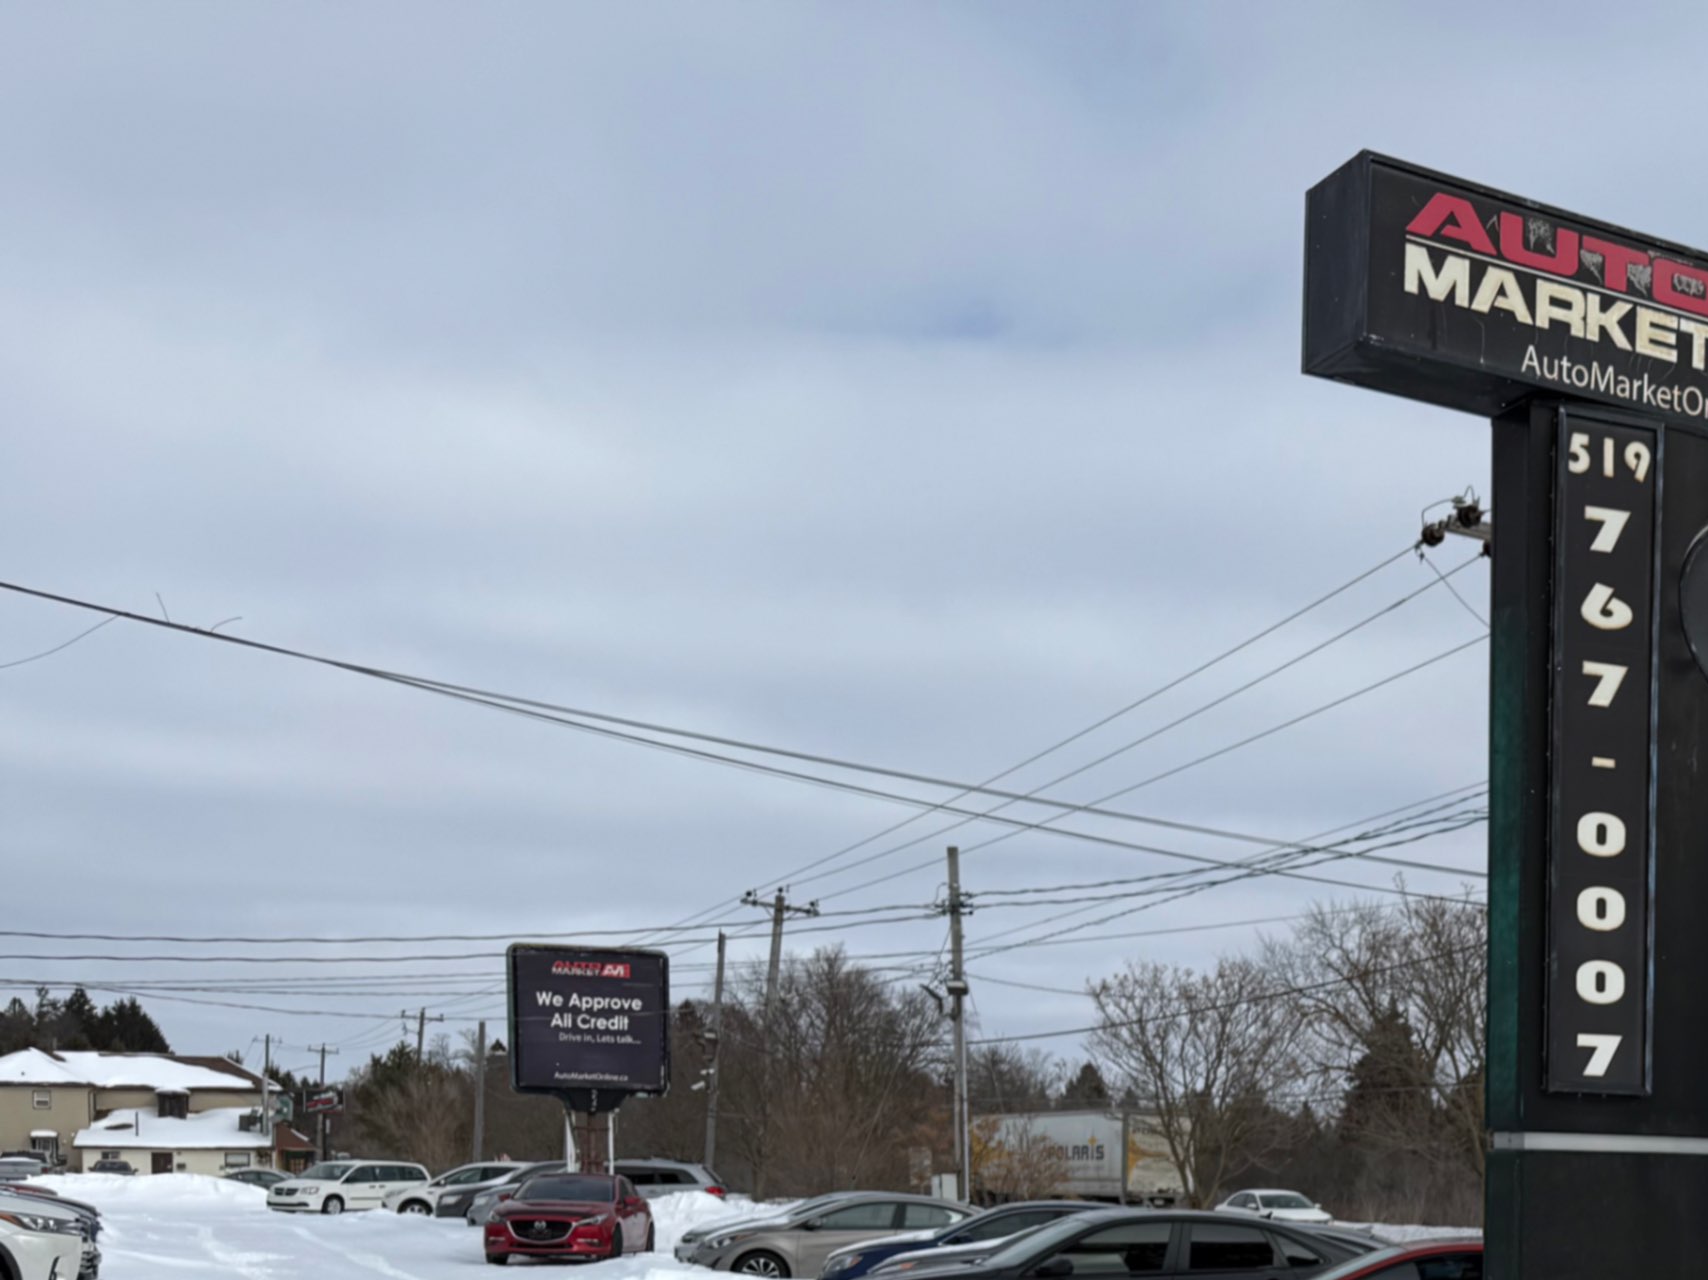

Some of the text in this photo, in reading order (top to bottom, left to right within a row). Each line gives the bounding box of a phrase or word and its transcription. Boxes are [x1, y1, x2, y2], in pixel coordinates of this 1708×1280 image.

[1567, 431, 1651, 483] 519
[536, 991, 642, 1012] We Approve
[550, 1013, 629, 1031] All Credit
[558, 1032, 581, 1042] Drive
[596, 1034, 615, 1044] Lets
